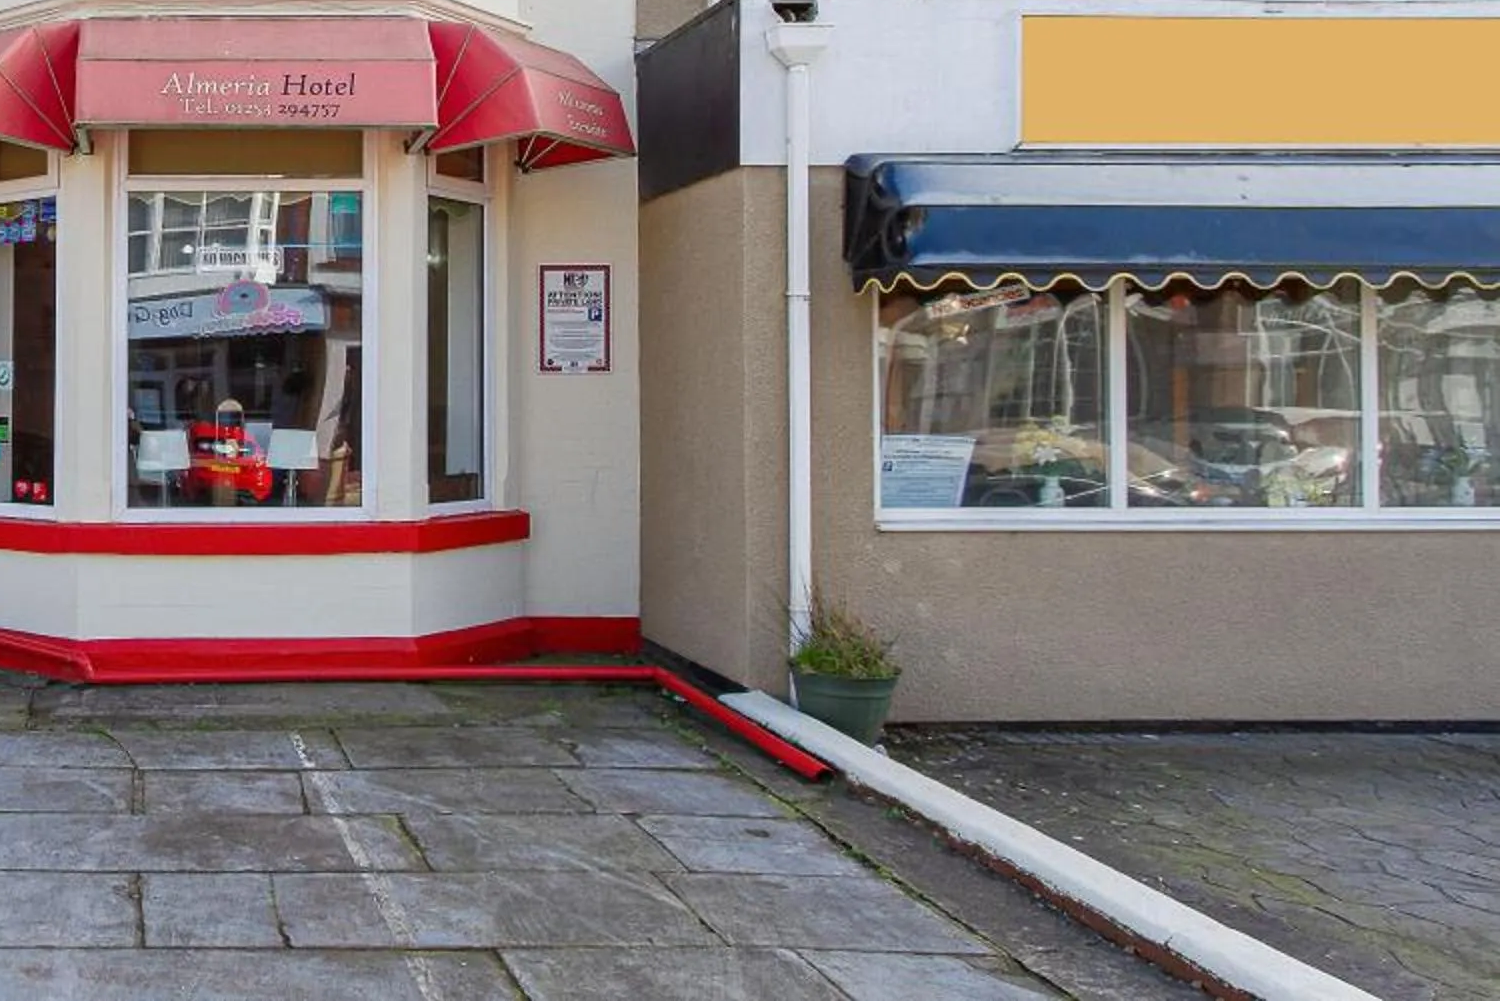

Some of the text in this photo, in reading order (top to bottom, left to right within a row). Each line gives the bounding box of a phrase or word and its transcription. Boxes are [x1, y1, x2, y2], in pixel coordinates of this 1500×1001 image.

[160, 72, 355, 96] Almeria Hotel
[180, 97, 218, 114] Tel.
[278, 104, 341, 118] 294757
